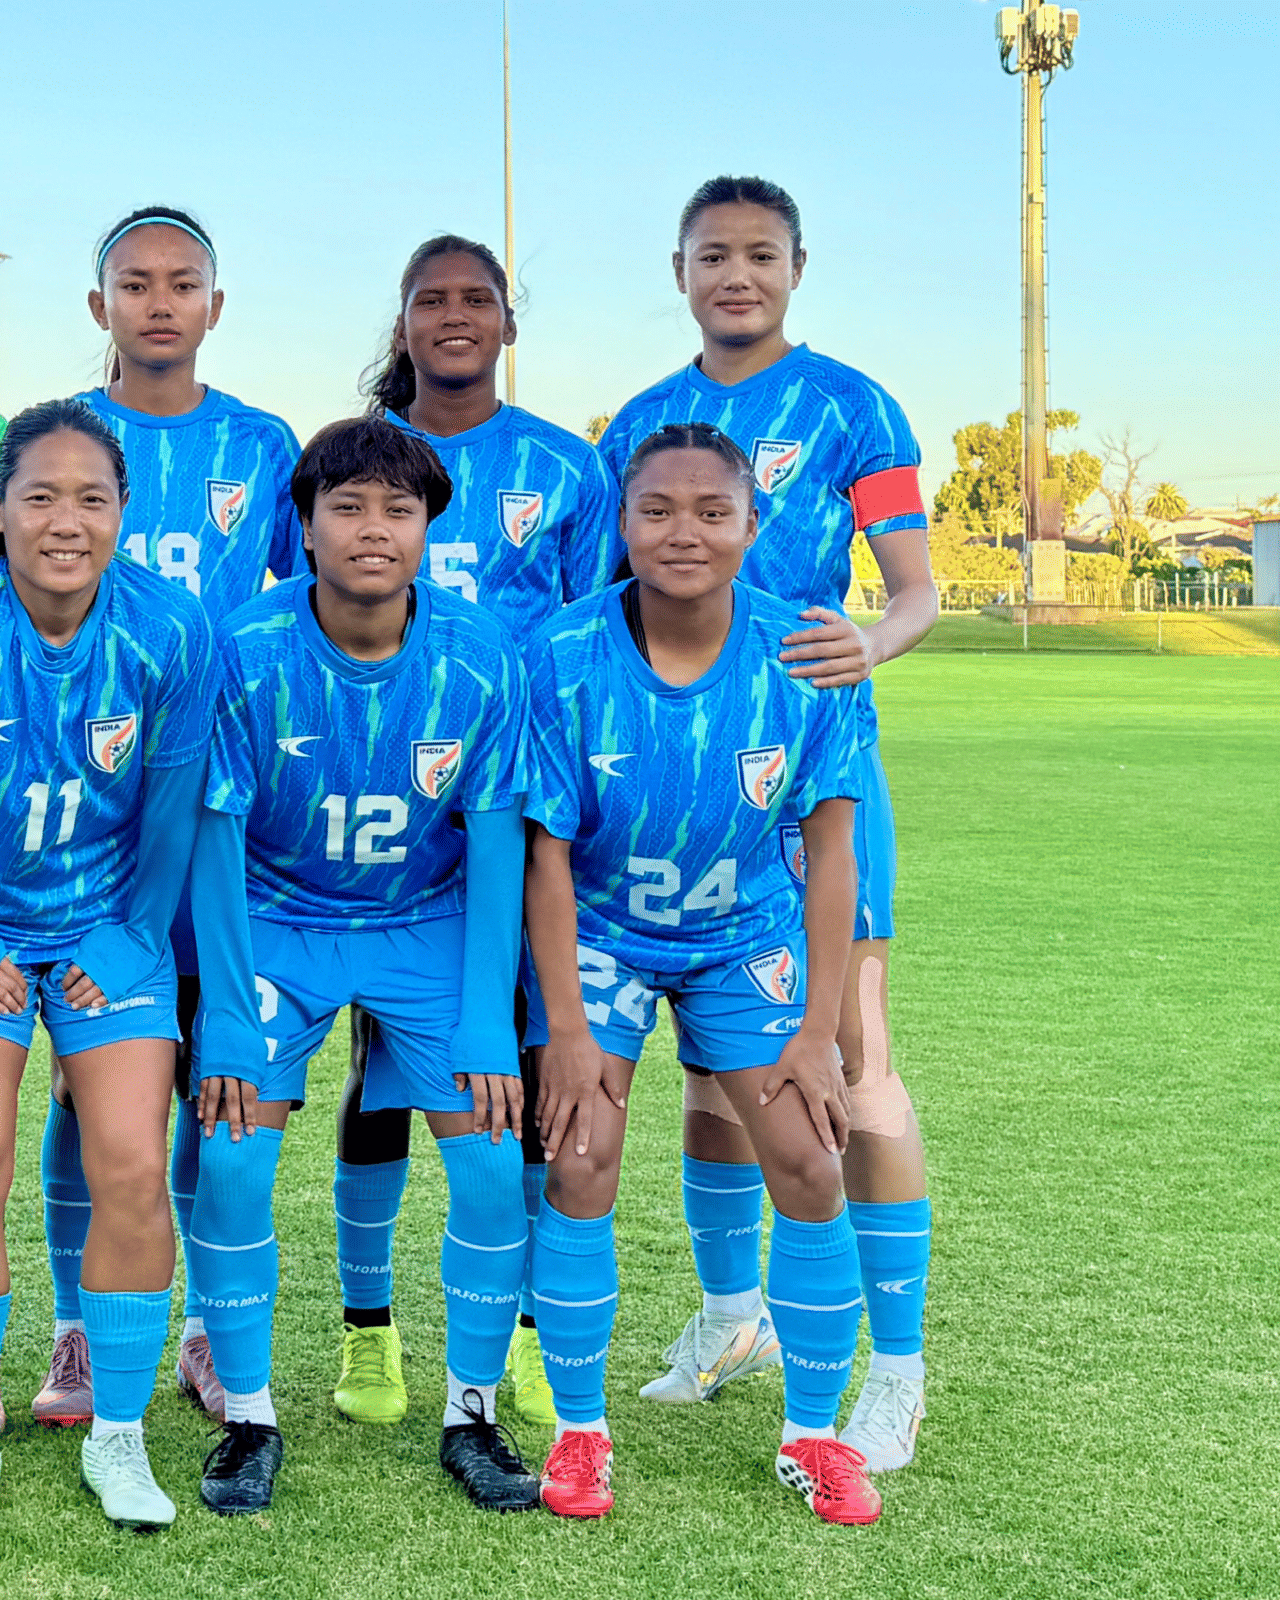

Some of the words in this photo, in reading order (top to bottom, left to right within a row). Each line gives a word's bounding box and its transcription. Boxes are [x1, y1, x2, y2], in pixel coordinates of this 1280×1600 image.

[212, 486, 233, 494] INDIA
[505, 497, 528, 505] INDIA
[94, 724, 120, 733] INDIA
[745, 755, 769, 764] INDIA
[23, 779, 82, 851] 11
[320, 794, 409, 864] 12
[628, 857, 737, 926] 24
[753, 958, 778, 970] INDIA
